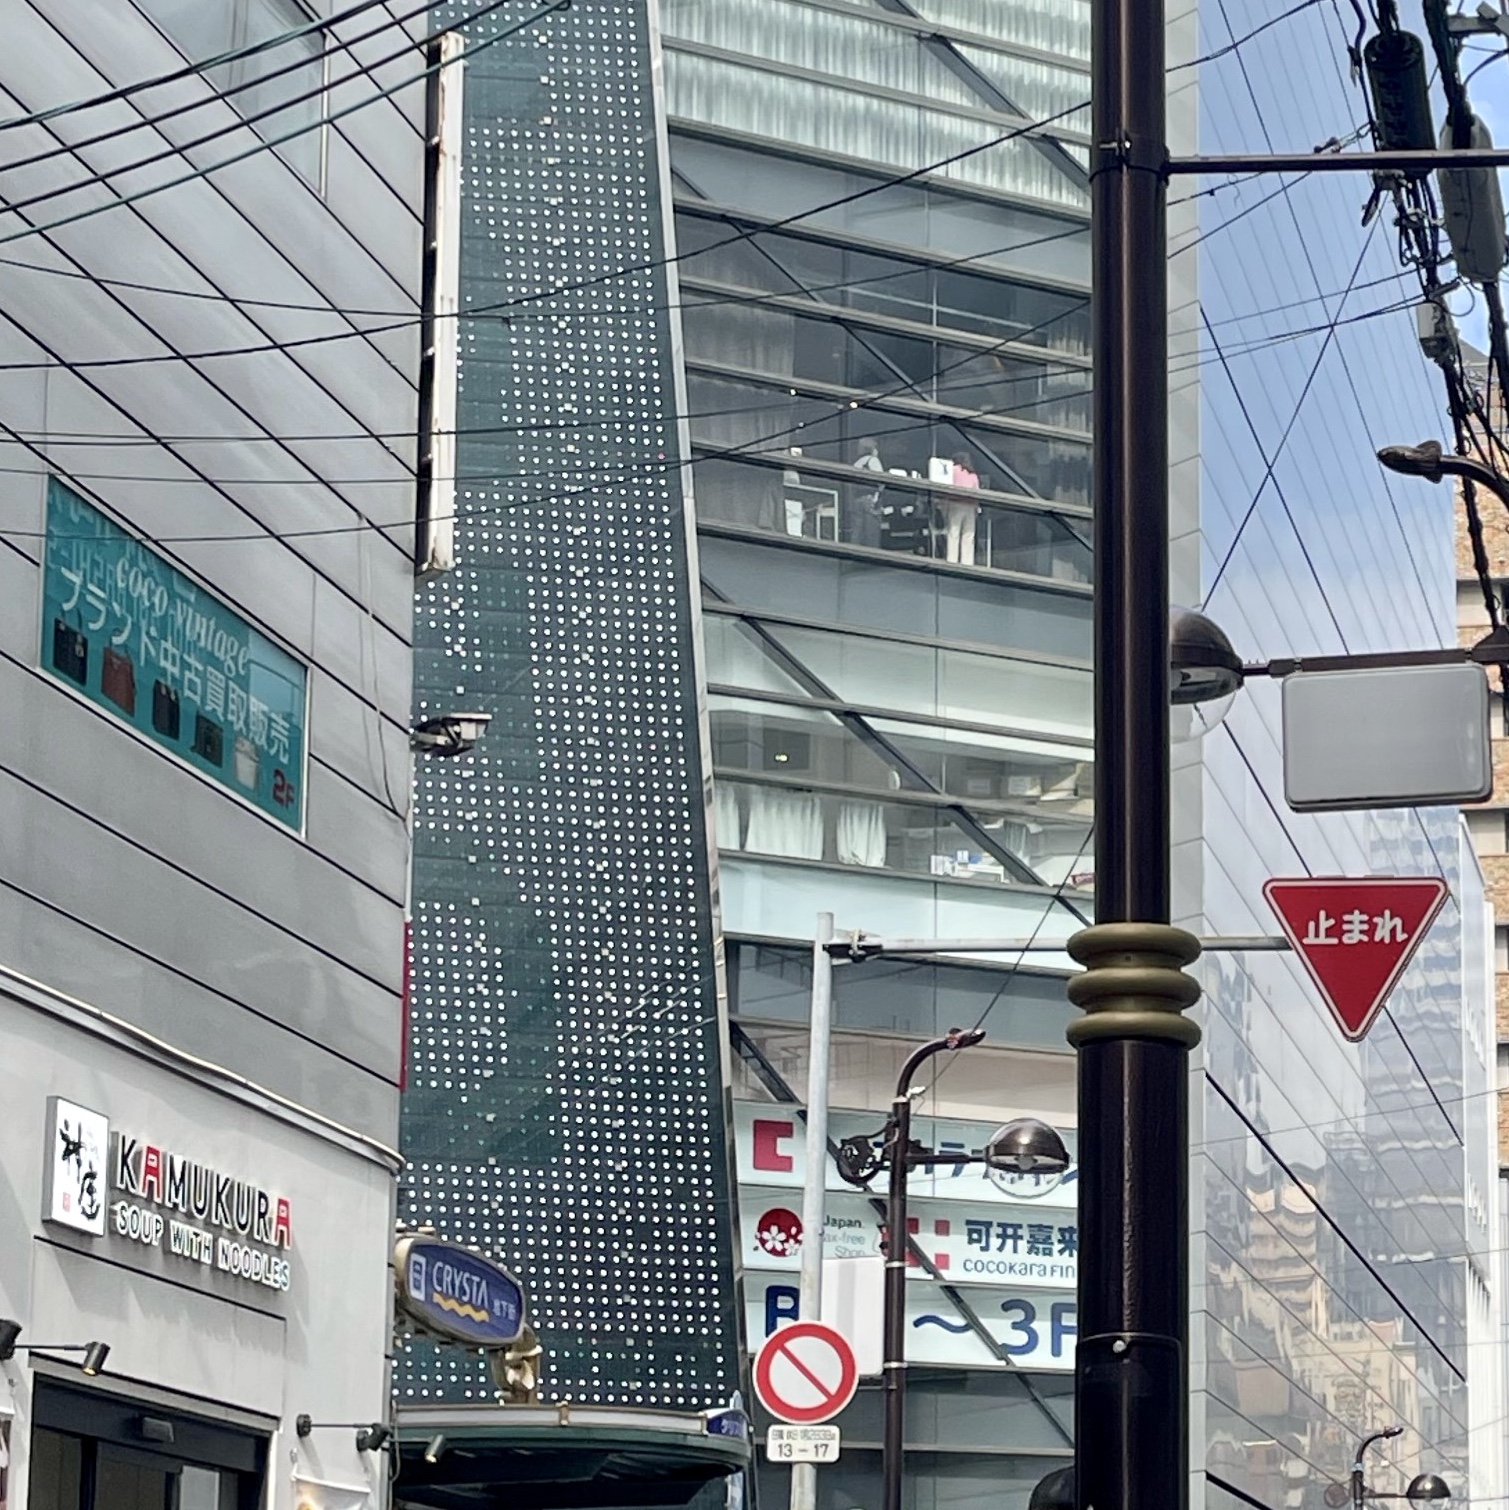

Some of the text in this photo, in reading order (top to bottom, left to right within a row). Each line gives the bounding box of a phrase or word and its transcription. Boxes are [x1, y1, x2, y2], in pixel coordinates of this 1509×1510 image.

[175, 599, 250, 677] vintage
[273, 768, 295, 809] 2F
[1302, 909, 1409, 945] 止まれ
[115, 1133, 292, 1250] KAMUKURA
[116, 1200, 291, 1292] SOUP WITH NOODLES
[823, 1231, 866, 1245] ax-free
[432, 1261, 489, 1309] CRYSTA
[778, 1443, 793, 1458] 13
[814, 1443, 829, 1458] 17
